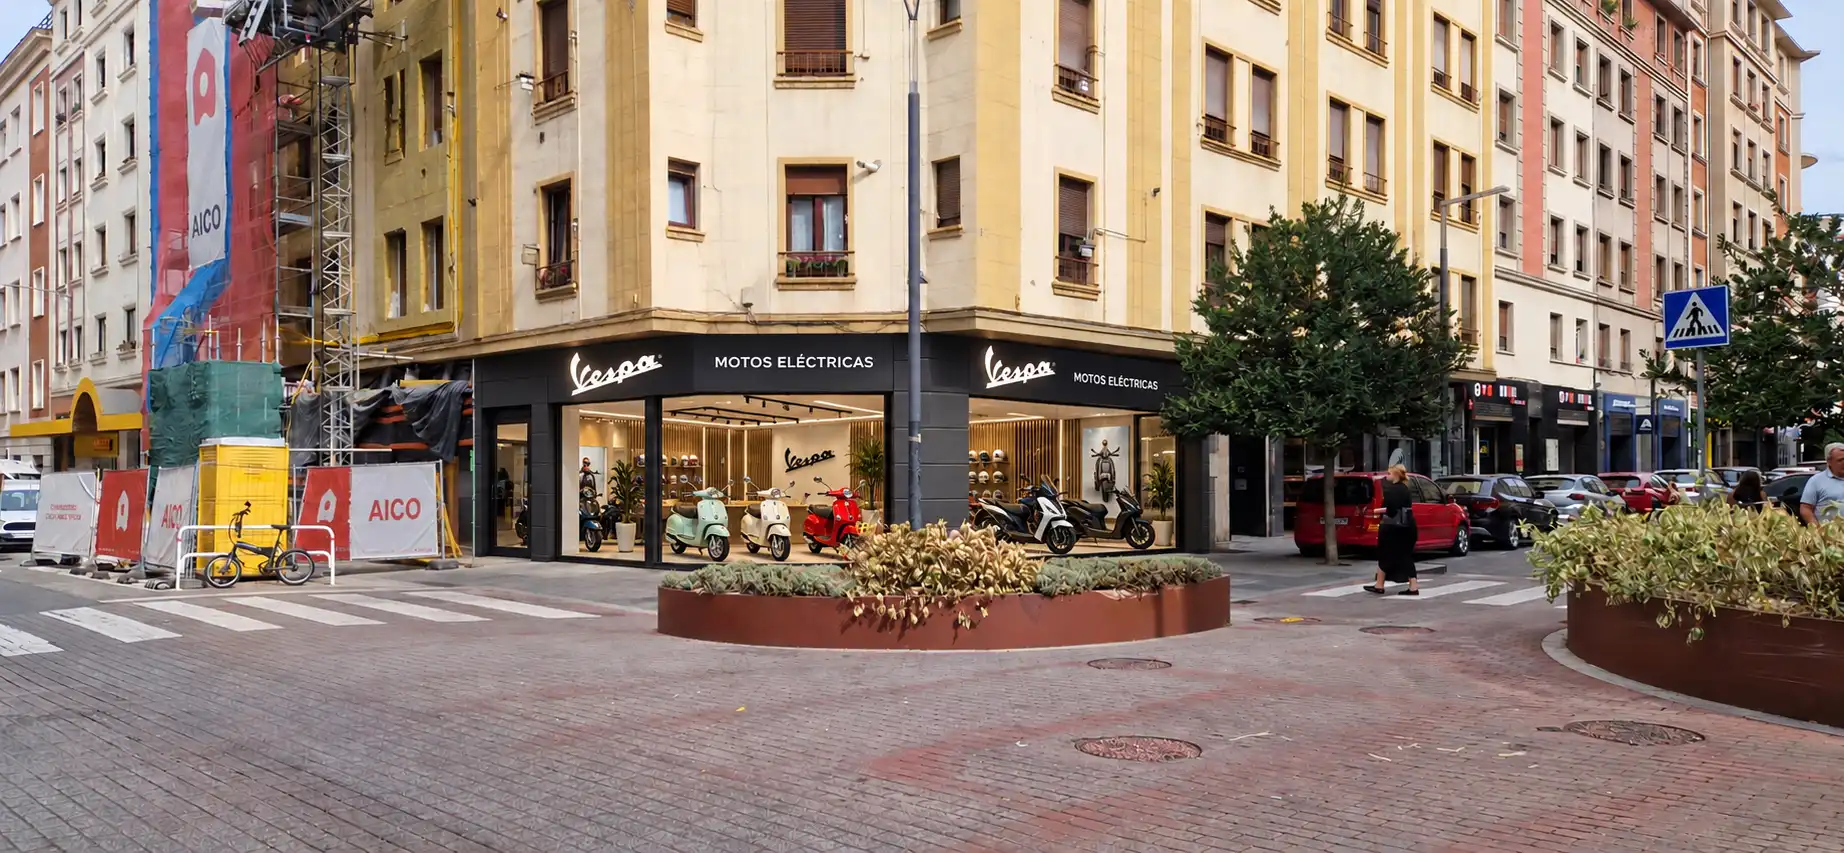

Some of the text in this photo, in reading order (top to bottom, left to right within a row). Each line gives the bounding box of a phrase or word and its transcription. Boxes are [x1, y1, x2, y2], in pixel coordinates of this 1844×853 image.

[192, 204, 221, 239] AICO
[715, 354, 874, 368] MOTOS ELÉCTRICAS
[985, 345, 1056, 389] Vespa
[570, 352, 662, 396] Vespa
[1073, 372, 1159, 390] MOTOS ELÉCTRICAS
[785, 447, 836, 473] Vespa
[161, 504, 183, 529] AICO
[368, 497, 421, 522] AICO
